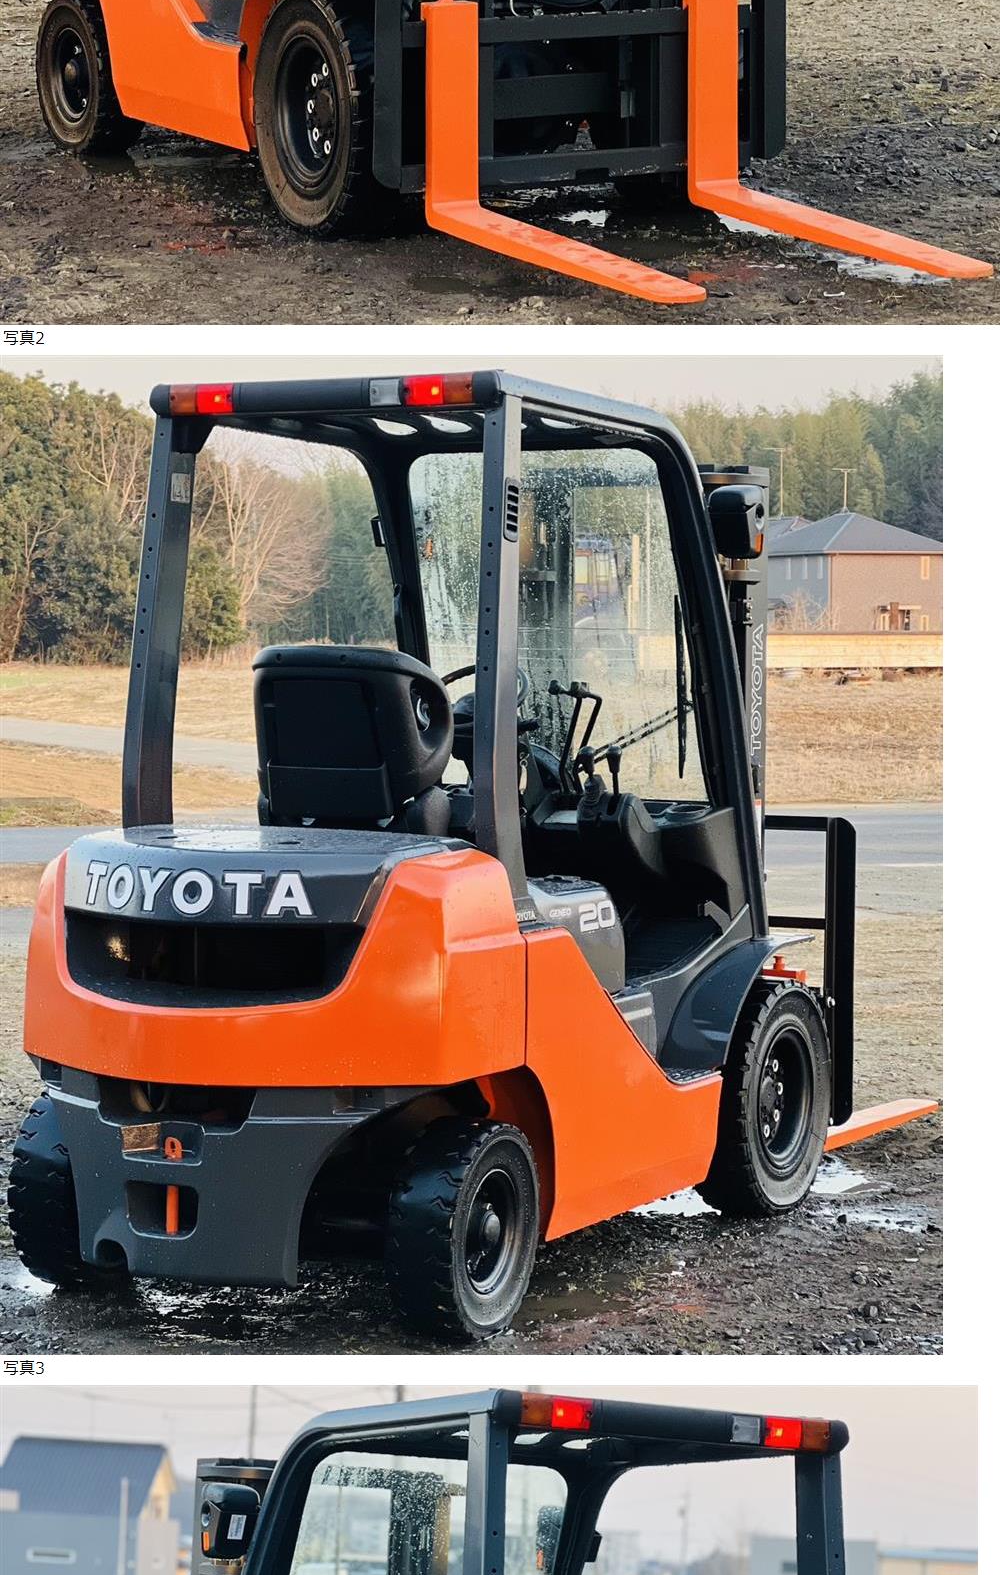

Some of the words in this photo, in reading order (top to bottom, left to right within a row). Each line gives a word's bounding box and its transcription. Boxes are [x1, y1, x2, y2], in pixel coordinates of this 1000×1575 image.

[750, 624, 763, 756] TOYOTA
[86, 860, 314, 917] TOYOTA
[516, 910, 536, 921] OYOTA
[578, 899, 615, 932] 20
